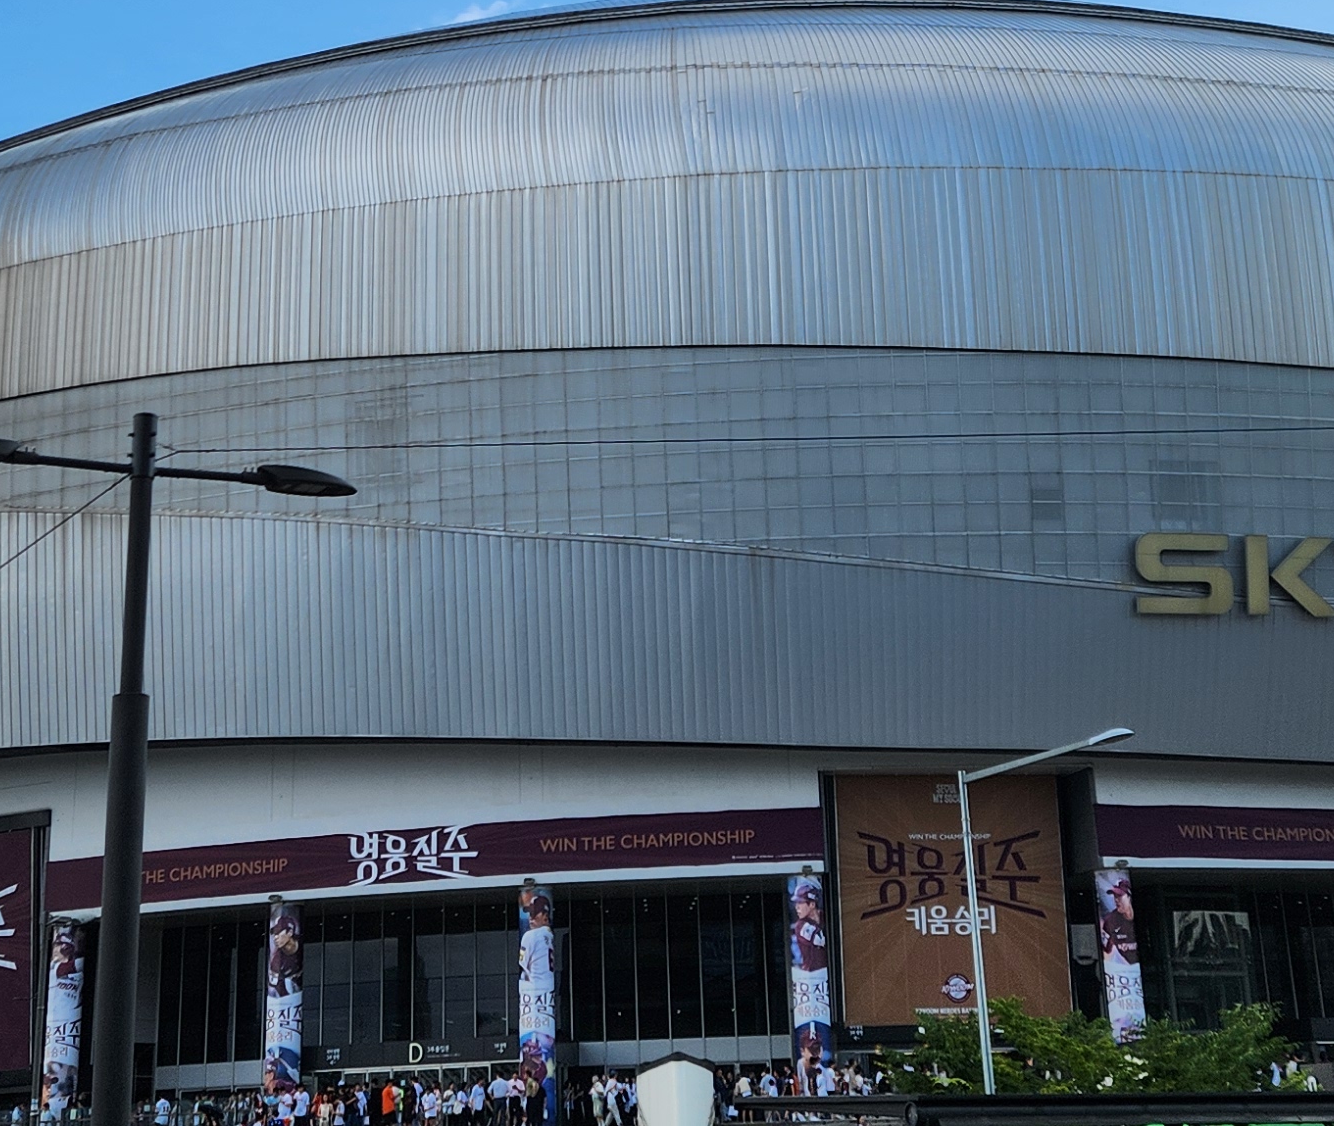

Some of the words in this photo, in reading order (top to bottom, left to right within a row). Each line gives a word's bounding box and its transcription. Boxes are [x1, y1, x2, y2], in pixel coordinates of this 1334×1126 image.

[539, 838, 577, 853] WIN
[581, 836, 616, 851] THE
[620, 829, 755, 849] CHAMPIONSHIP
[939, 833, 991, 841] CHAMPNSHIP
[1178, 825, 1213, 839] WIN
[1216, 826, 1249, 841] THE
[169, 858, 288, 882] CHAMPIONSHIP
[906, 905, 997, 936] 키움승리
[409, 1042, 423, 1063] D
